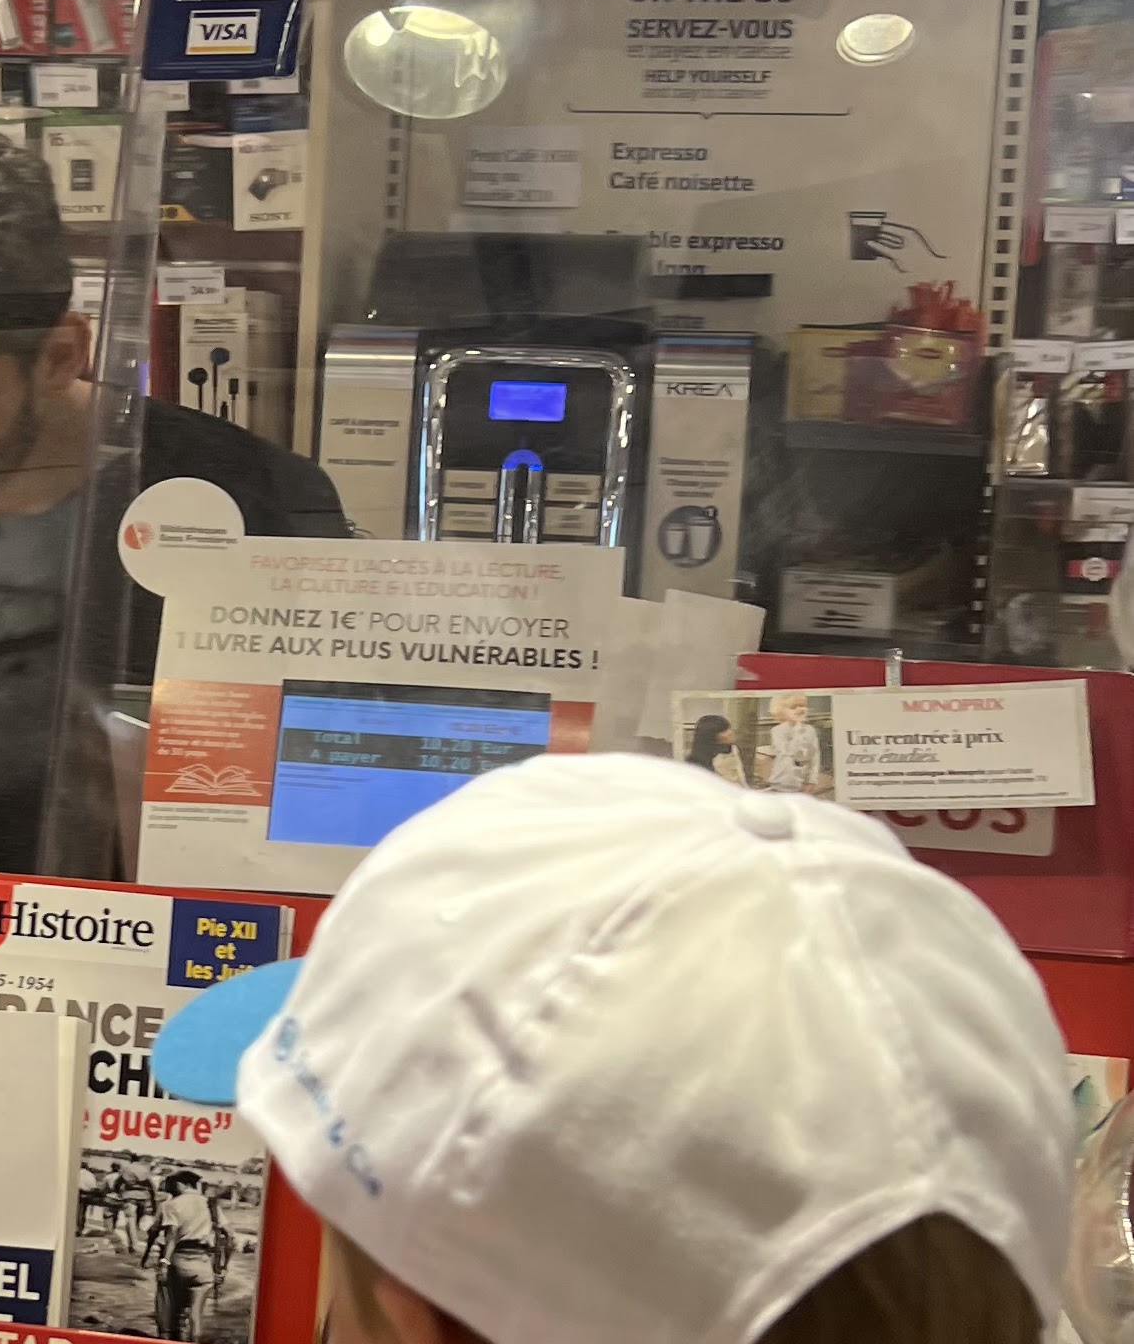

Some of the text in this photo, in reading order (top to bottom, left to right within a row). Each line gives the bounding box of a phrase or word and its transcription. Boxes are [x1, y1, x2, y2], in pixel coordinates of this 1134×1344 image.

[200, 23, 248, 41] VISA
[627, 18, 794, 39] SERVEZ-VOUS
[611, 142, 708, 164] Expresso
[609, 171, 756, 192] Café noisette
[686, 235, 785, 254] expresso
[298, 577, 379, 595] CULTURE
[210, 605, 323, 629] DONNEZ
[369, 611, 441, 634] POUR
[449, 614, 571, 639] ENVOYER
[193, 631, 263, 654] LIVRE
[268, 635, 324, 656] AUX
[330, 638, 393, 660] PLUS
[400, 639, 583, 669] VULNÉRABLES
[901, 698, 1005, 713] MONOPRIX
[845, 730, 882, 747] Une
[884, 728, 950, 746] rentrée
[965, 727, 1005, 748] prix
[196, 918, 258, 940] Pie XII
[214, 942, 237, 960] et
[185, 959, 213, 981] les
